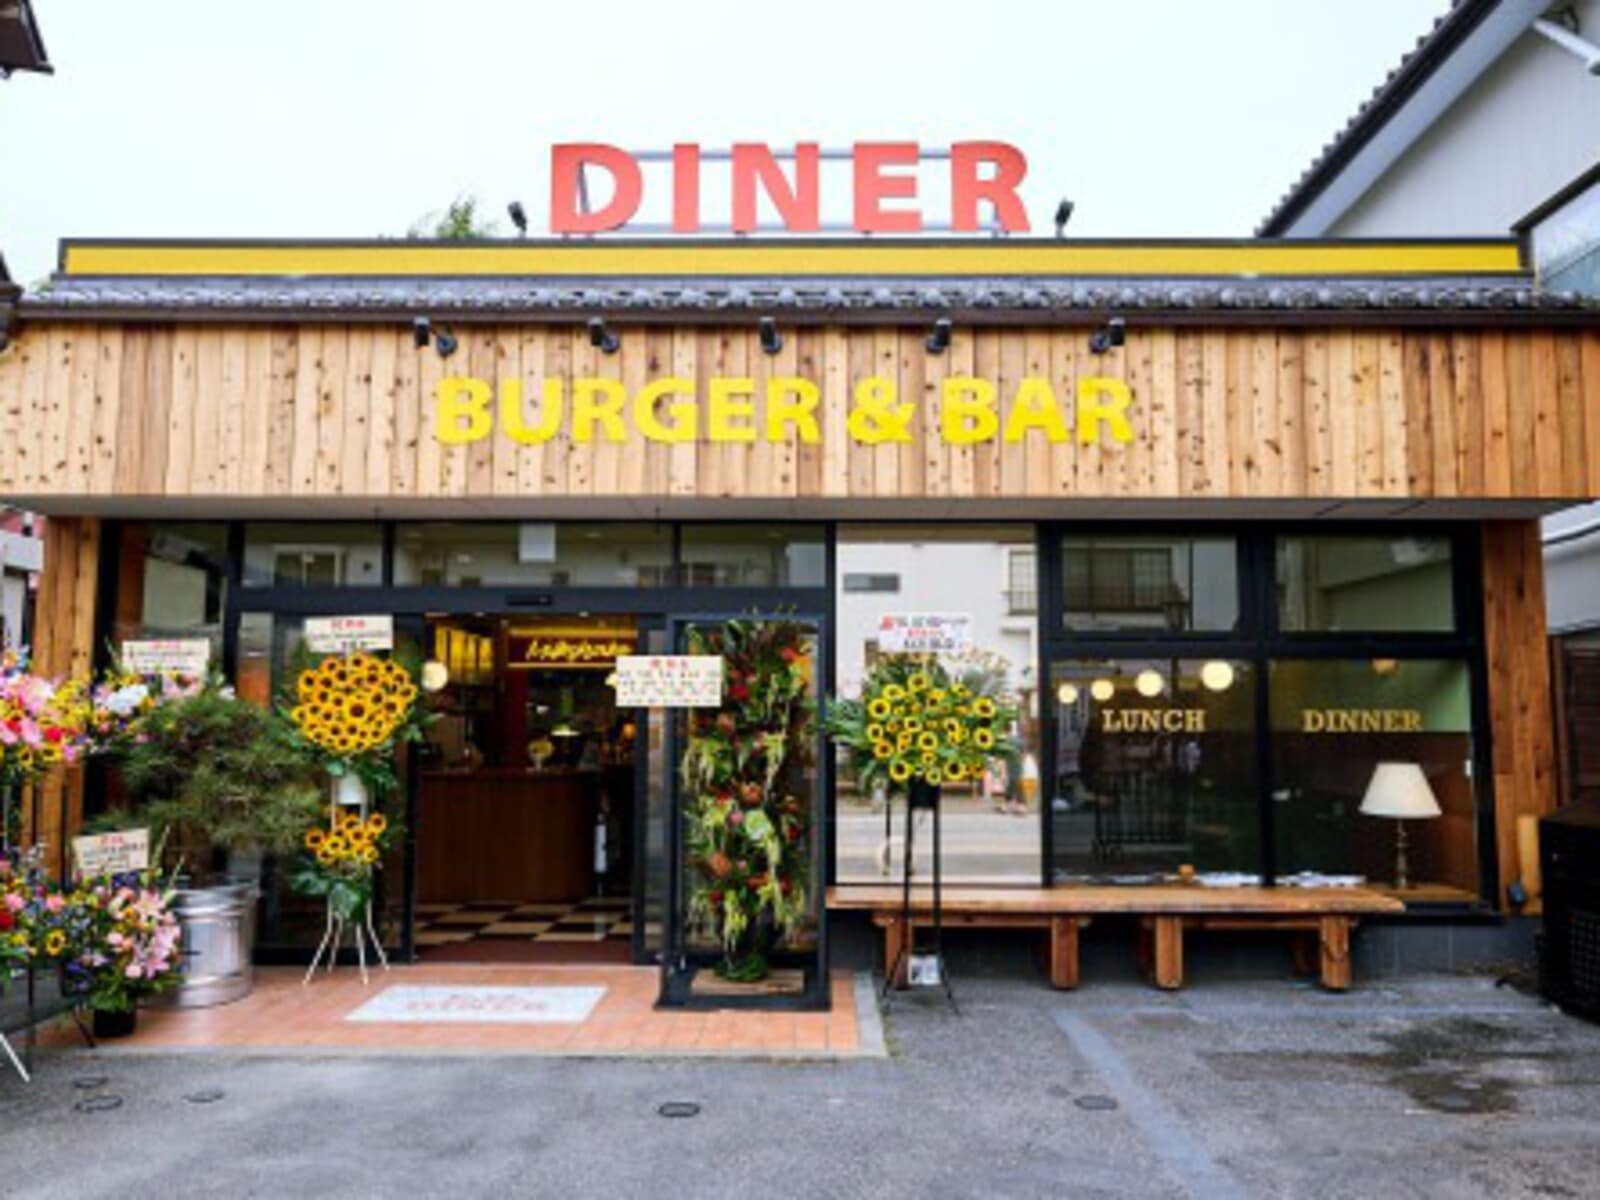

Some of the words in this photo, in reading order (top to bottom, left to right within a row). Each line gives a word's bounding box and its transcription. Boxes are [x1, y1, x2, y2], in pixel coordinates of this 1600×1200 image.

[549, 141, 1031, 234] DINER
[433, 375, 822, 445] BURGER
[846, 376, 914, 444] &
[940, 376, 1136, 445] BAR
[1101, 708, 1207, 735] LUNCH
[1302, 708, 1423, 735] DINNER
